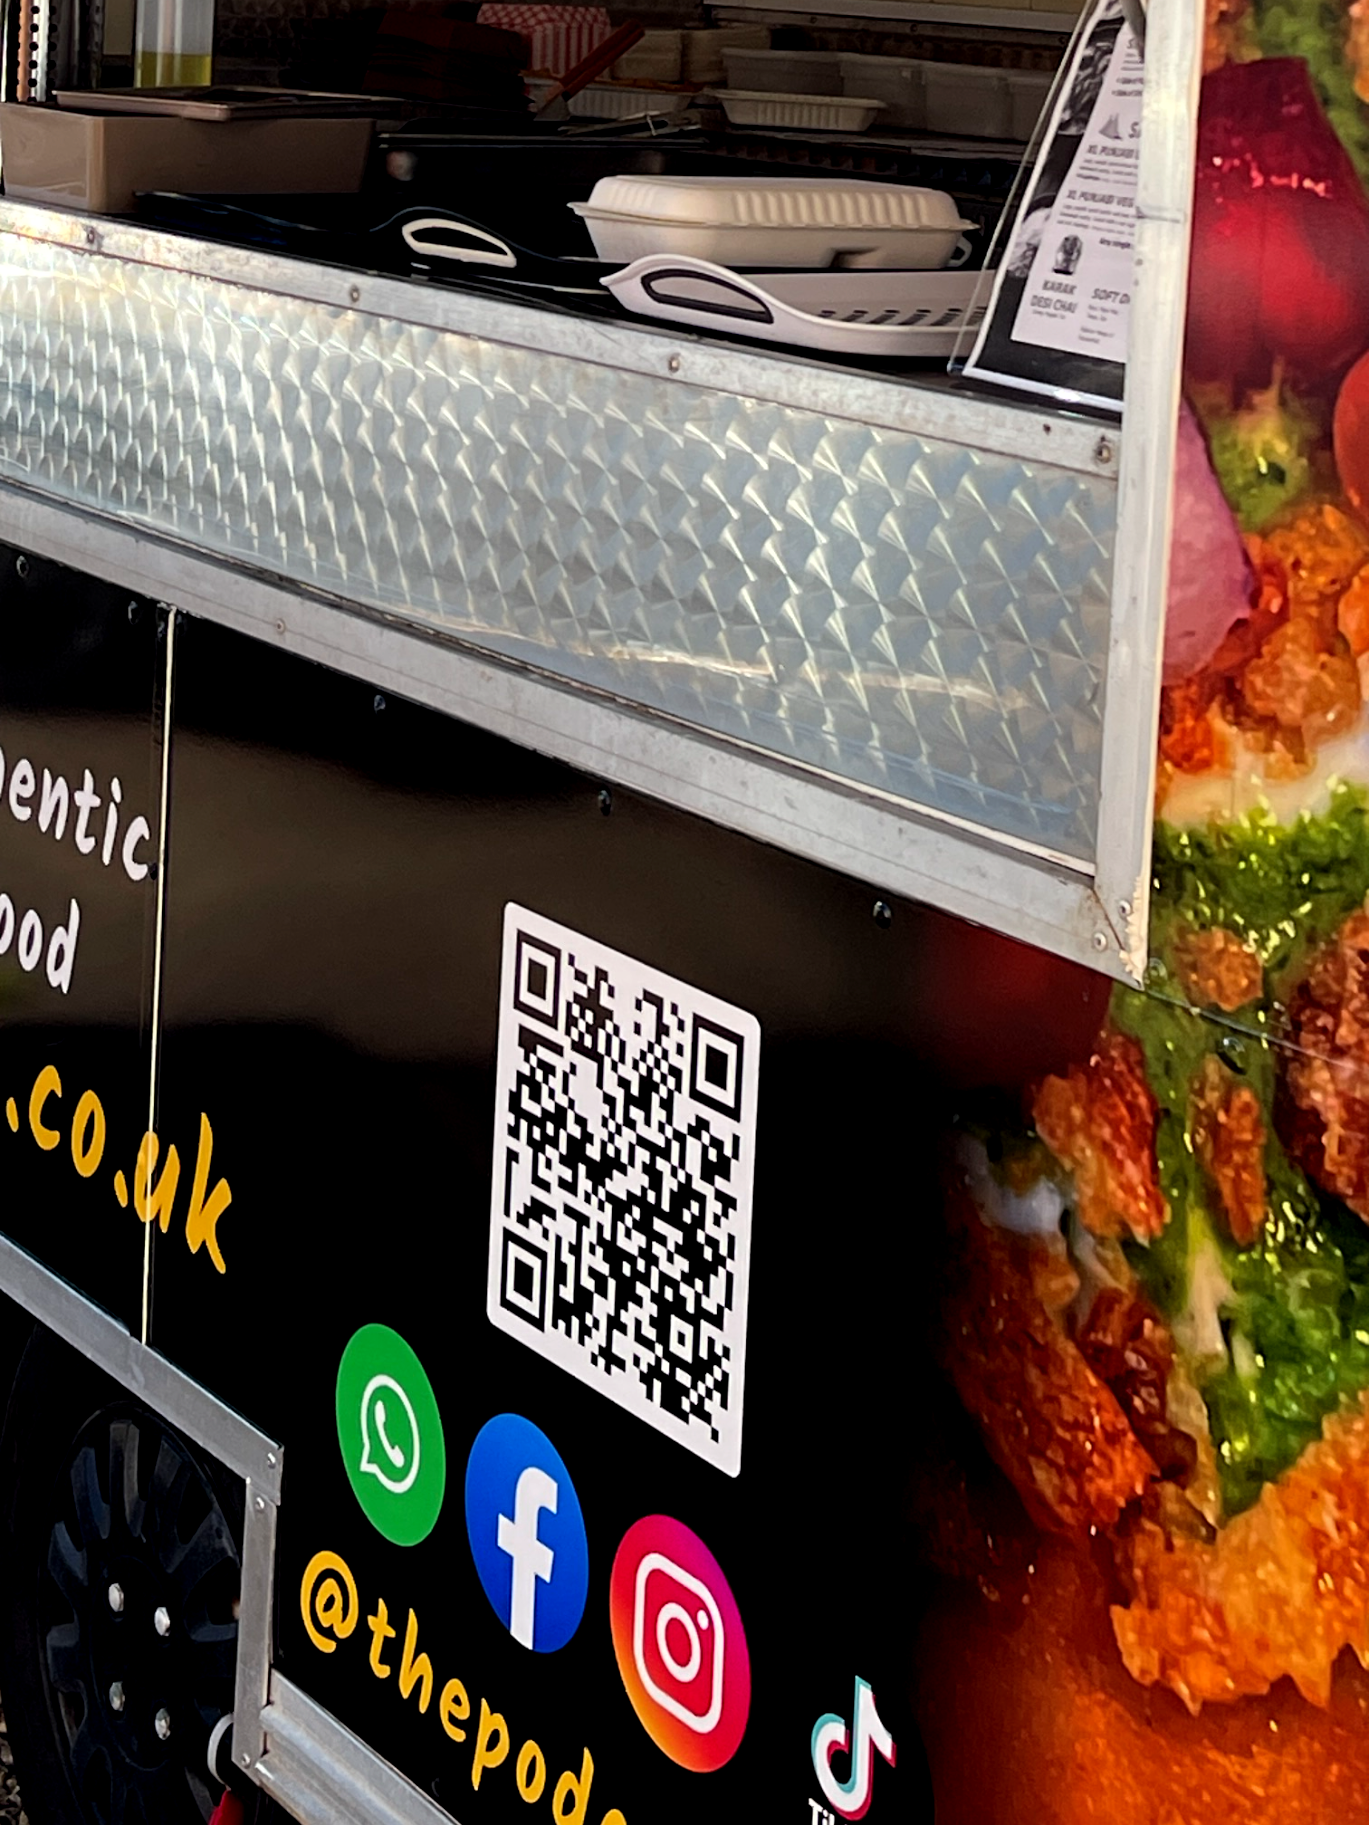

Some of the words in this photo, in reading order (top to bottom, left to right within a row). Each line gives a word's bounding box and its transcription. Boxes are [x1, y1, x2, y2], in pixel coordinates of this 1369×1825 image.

[1030, 294, 1053, 309] DESI
[1091, 288, 1120, 303] SOFT
[300, 1550, 628, 1825] @thepod
[808, 1798, 835, 1825] Ti
